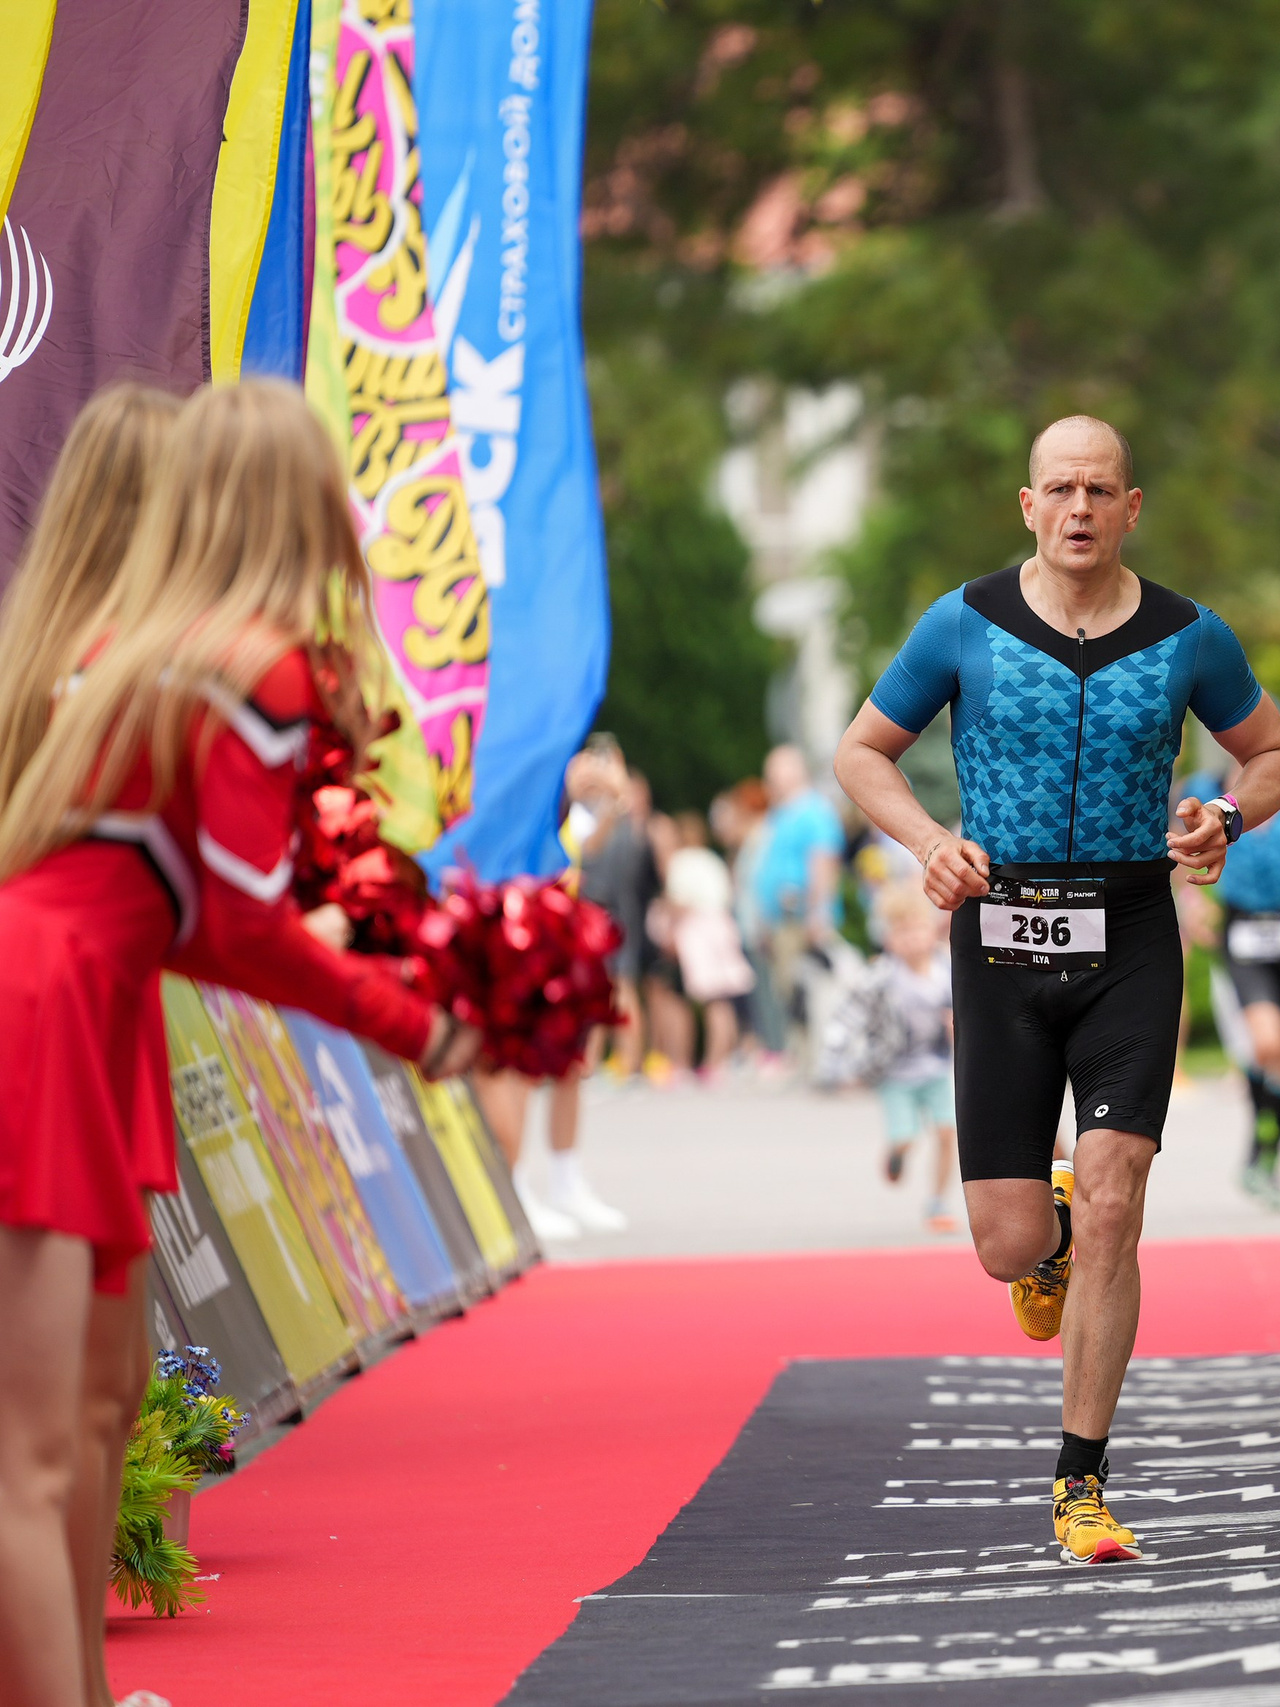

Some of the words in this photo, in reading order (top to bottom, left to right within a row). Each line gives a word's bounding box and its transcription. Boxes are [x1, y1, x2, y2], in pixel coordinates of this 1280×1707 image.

[497, 93, 532, 342] СТРАХОВОЙ
[1020, 886, 1036, 896] IRON
[1042, 889, 1060, 897] STAR
[1011, 914, 1071, 947] 296
[1032, 954, 1050, 965] ILYA
[812, 1579, 1153, 1608] IRON
[772, 1648, 1158, 1683] IRON
